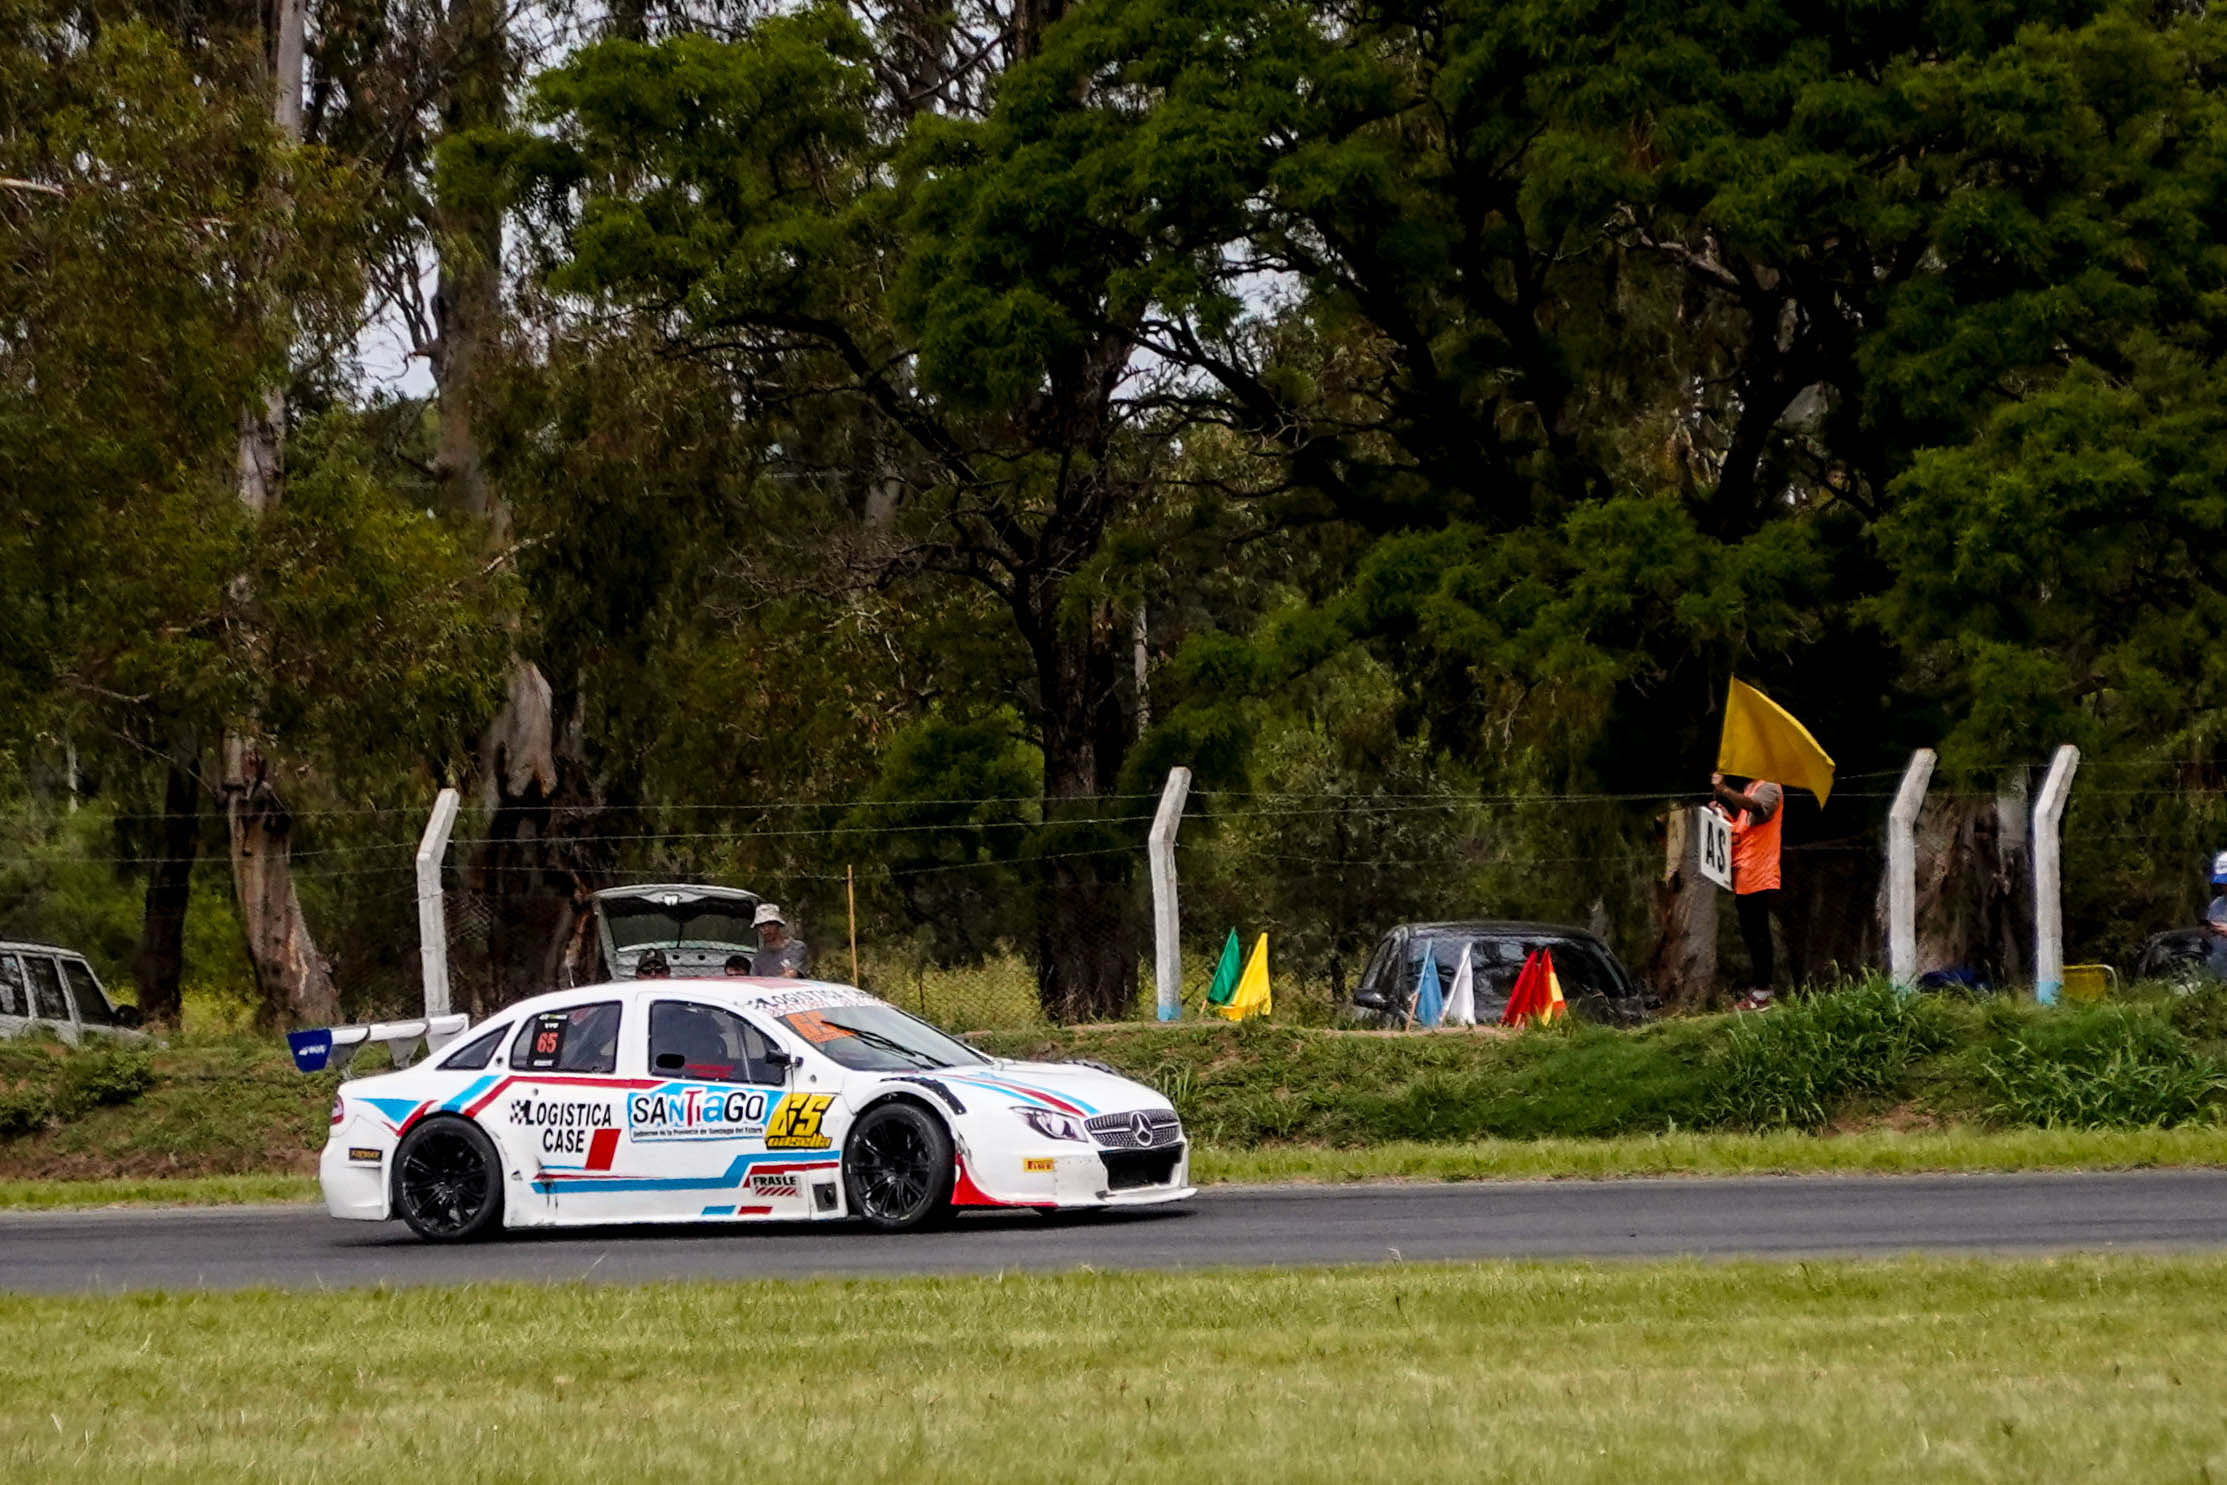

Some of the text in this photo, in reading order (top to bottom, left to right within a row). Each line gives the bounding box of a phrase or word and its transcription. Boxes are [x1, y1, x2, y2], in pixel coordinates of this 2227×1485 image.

[1706, 821, 1726, 874] AS
[537, 1032, 558, 1053] 65
[524, 1100, 612, 1127] LOGISTICA
[766, 1093, 836, 1136] 65
[542, 1128, 585, 1153] CASE
